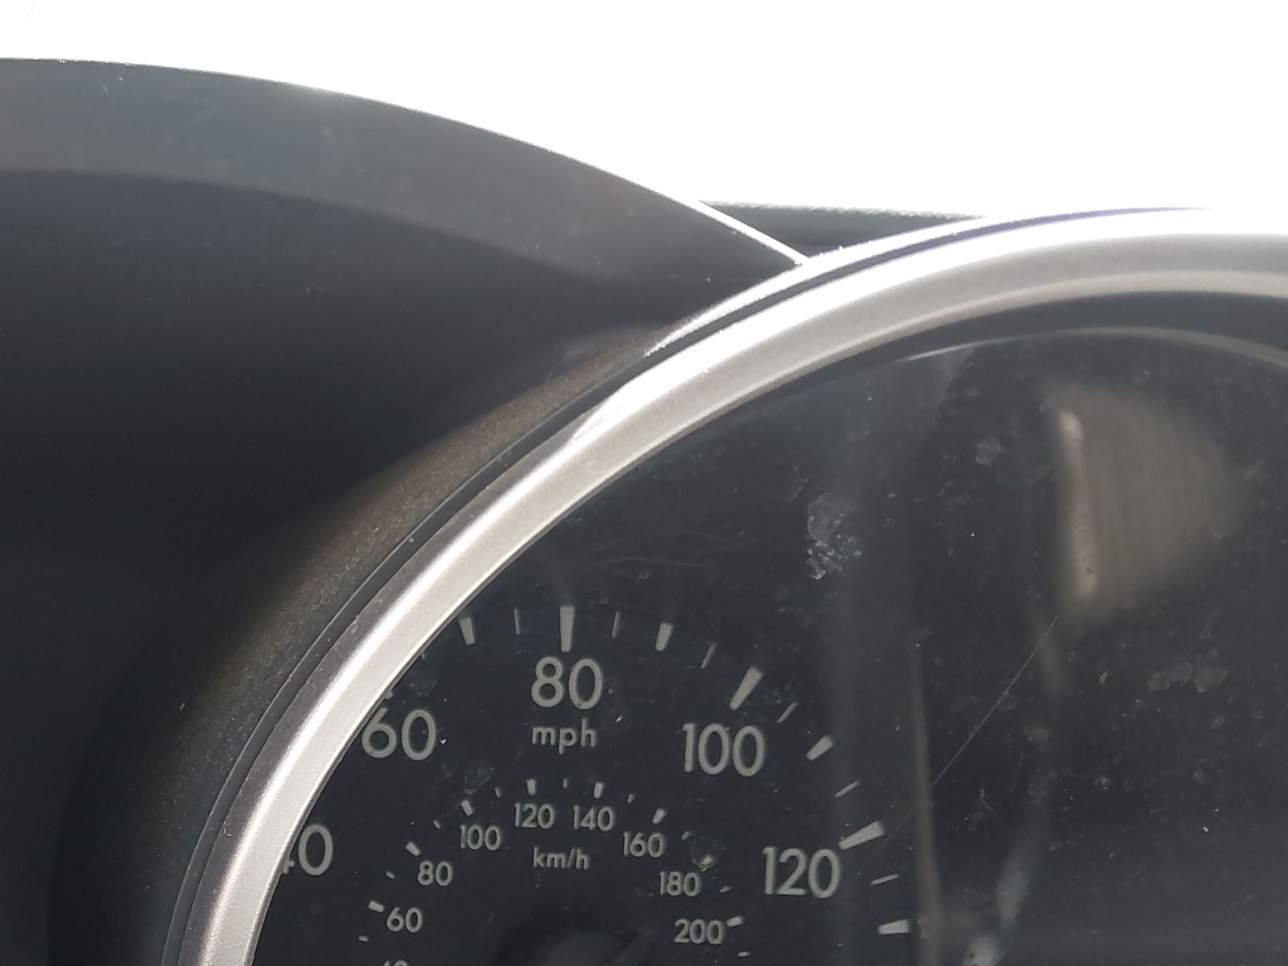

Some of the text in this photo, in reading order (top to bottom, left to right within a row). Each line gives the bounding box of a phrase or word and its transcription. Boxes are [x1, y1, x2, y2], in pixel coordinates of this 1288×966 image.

[530, 655, 604, 709] 80
[361, 709, 437, 761] 60
[530, 721, 598, 754] mph
[681, 723, 766, 777] 100
[514, 802, 556, 831] 120
[572, 805, 613, 832] 140
[459, 825, 502, 852] 100
[623, 831, 666, 859] 160
[532, 845, 590, 872] km/h
[762, 846, 840, 899] 120
[417, 861, 453, 888] 80
[659, 871, 700, 898] 180
[386, 906, 423, 934] 60
[674, 917, 724, 945] 200
